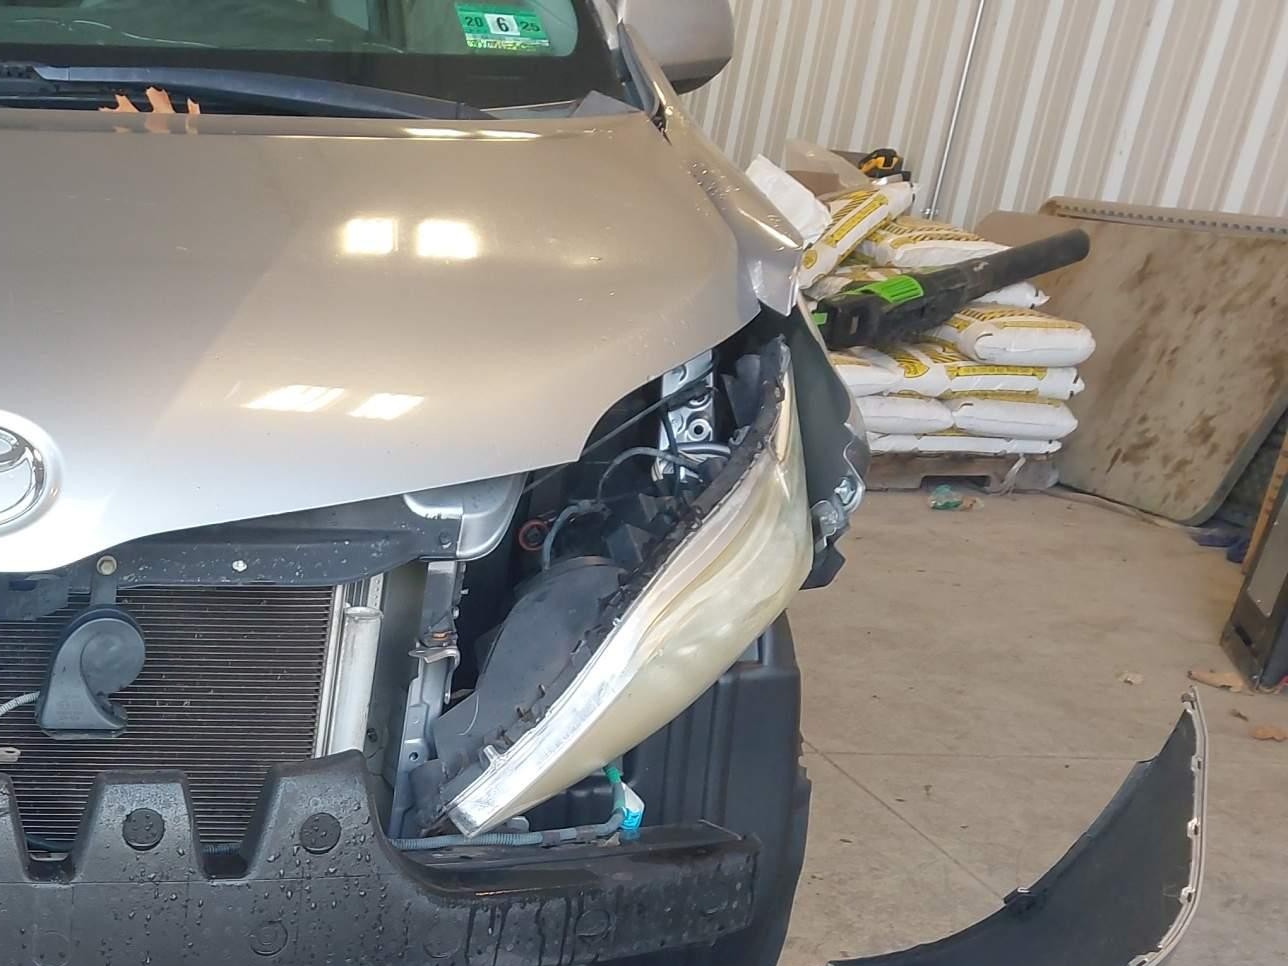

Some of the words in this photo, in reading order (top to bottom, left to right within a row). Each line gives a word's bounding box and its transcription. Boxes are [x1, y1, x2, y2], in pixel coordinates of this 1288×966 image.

[464, 16, 484, 28] 20
[496, 16, 510, 33] 6
[519, 21, 541, 33] 25
